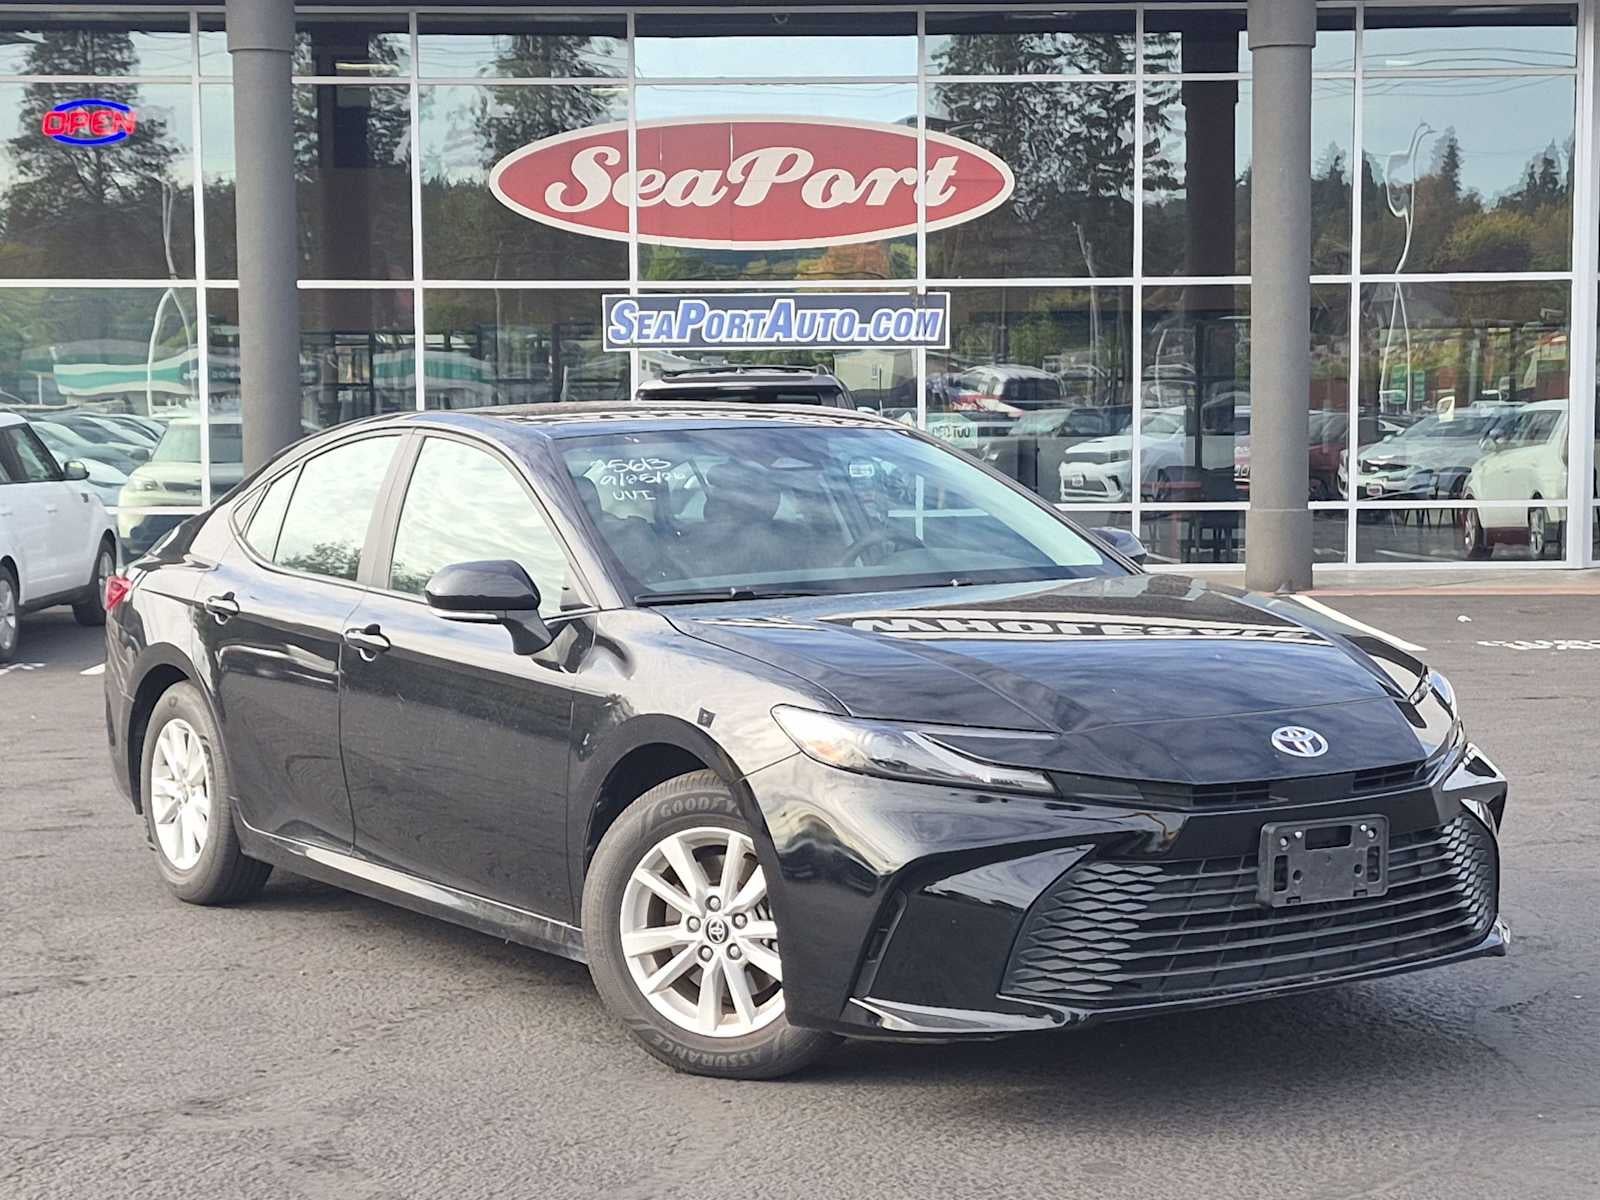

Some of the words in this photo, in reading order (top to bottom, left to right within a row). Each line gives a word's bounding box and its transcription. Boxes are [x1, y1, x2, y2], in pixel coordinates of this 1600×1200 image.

[42, 111, 136, 136] OPEN
[545, 146, 958, 213] SeaPort
[660, 797, 740, 818] GOODY
